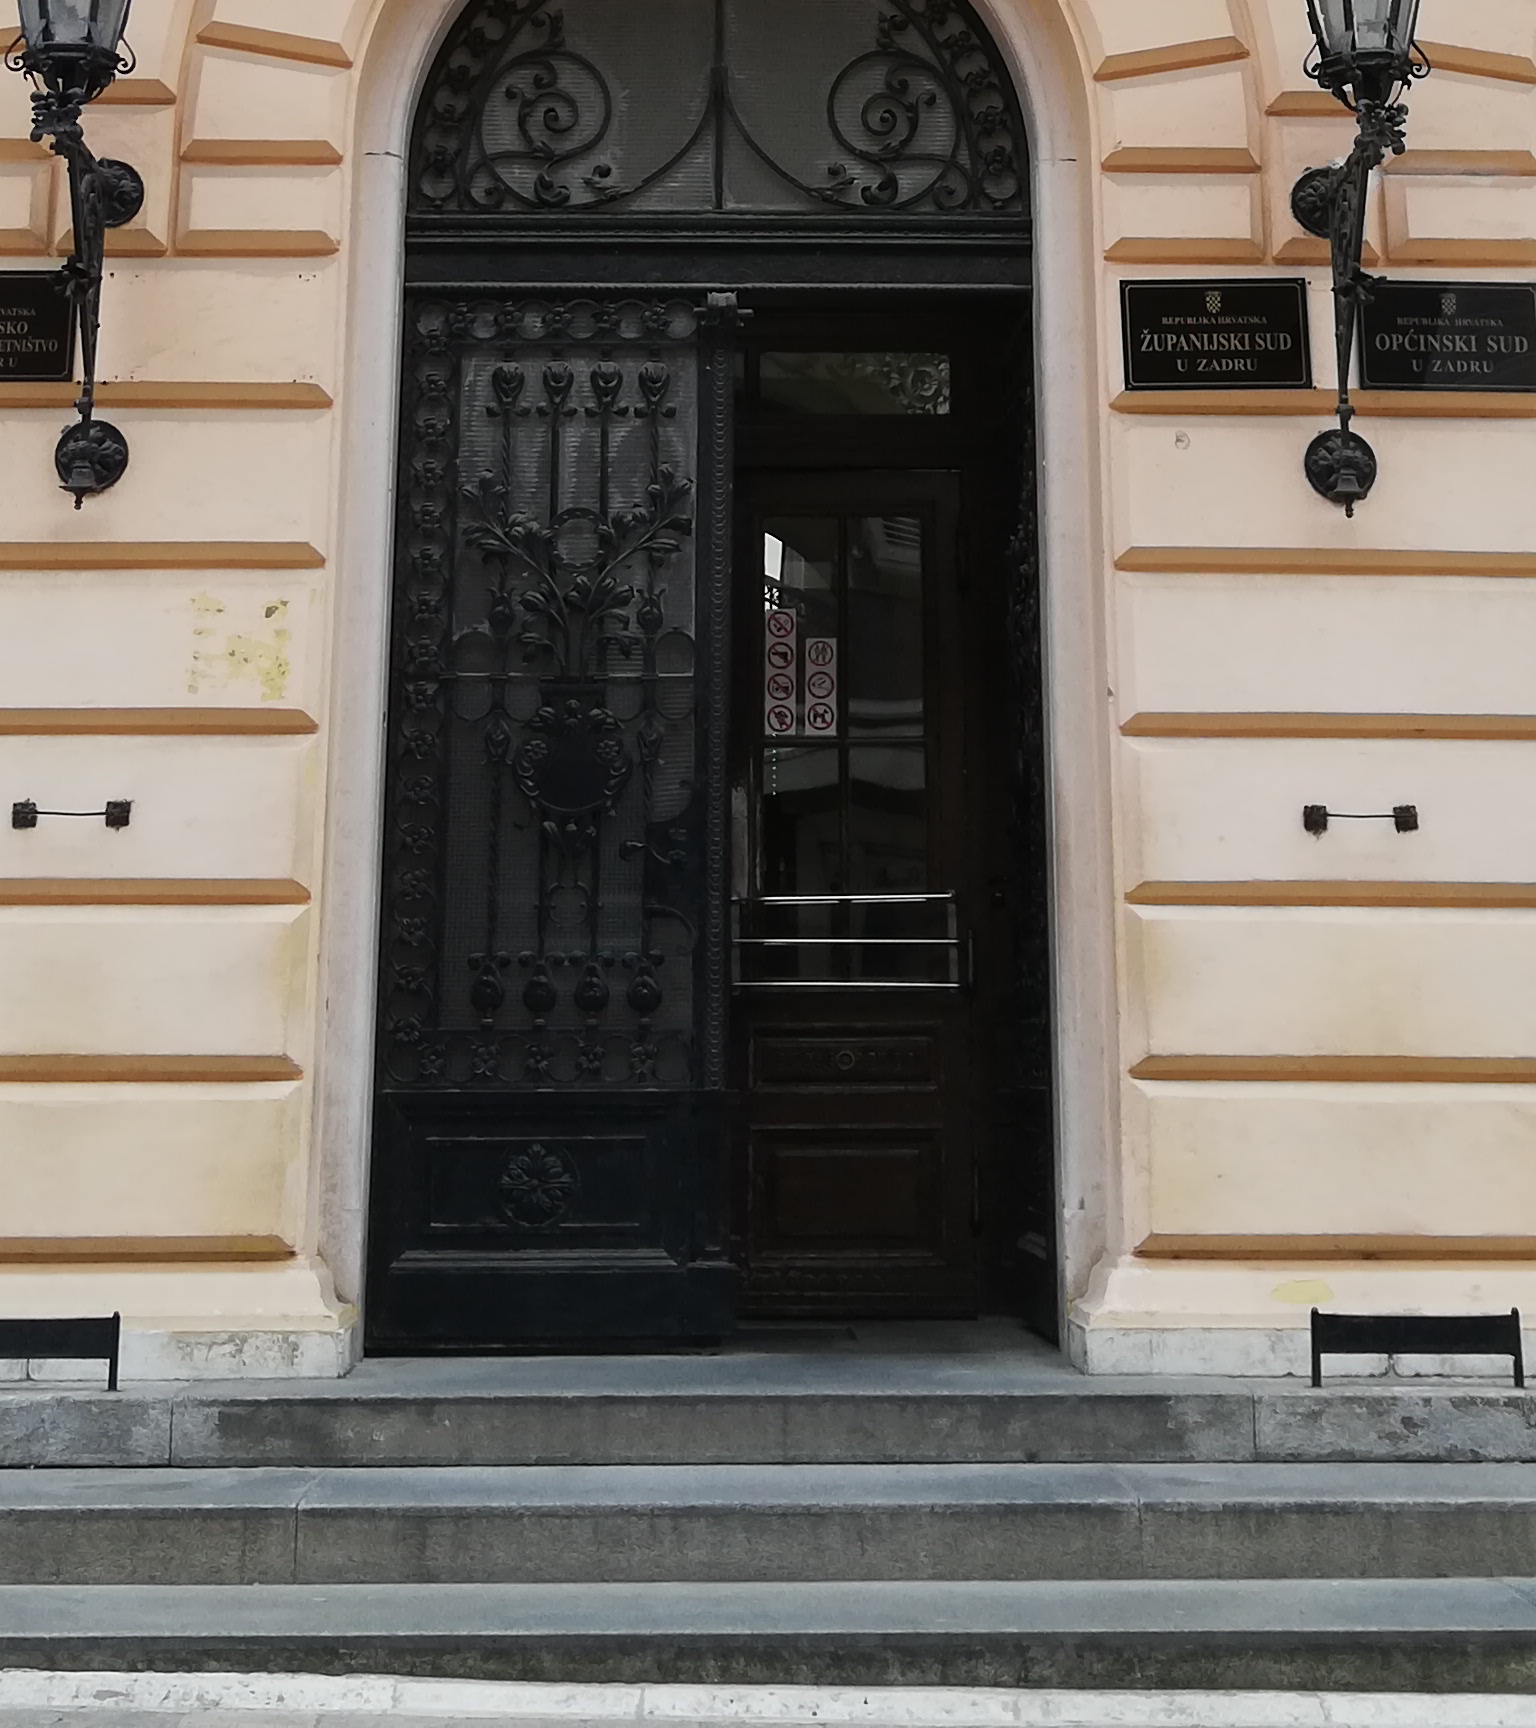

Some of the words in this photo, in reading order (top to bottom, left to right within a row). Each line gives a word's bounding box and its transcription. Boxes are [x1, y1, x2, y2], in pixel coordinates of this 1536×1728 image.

[1140, 328, 1250, 351] ŽUPANIJSKI
[1254, 332, 1292, 351] SUD
[1375, 328, 1477, 352] OPĆINSKI
[1486, 335, 1529, 353] SUD
[1176, 358, 1188, 372] U
[1196, 358, 1258, 372] ZADRU
[1411, 359, 1423, 372] U
[1431, 359, 1494, 373] ZADRU
